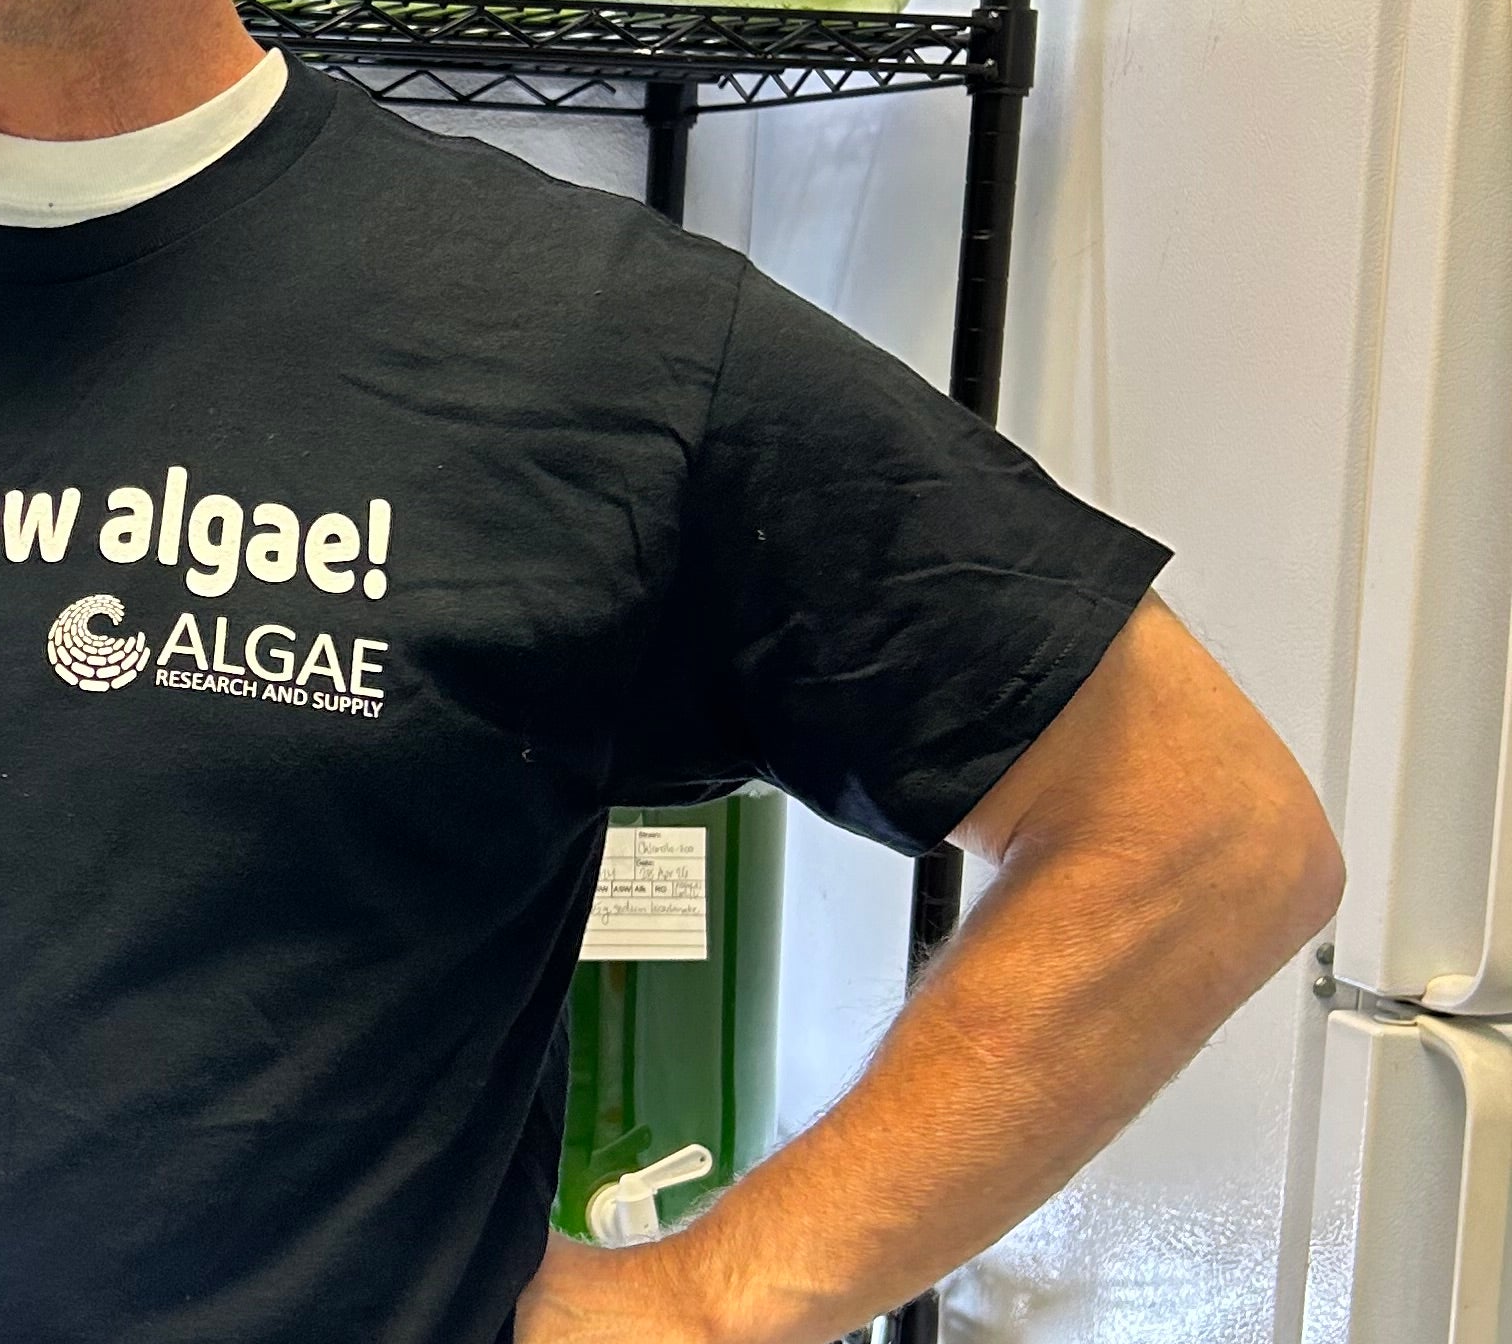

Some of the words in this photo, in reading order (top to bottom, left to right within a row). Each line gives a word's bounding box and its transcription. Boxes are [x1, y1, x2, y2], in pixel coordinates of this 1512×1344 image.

[98, 466, 393, 600] algae!
[155, 668, 258, 699] RESEARCH
[262, 682, 309, 706] AND
[313, 688, 384, 719] SUPPLY
[156, 612, 390, 699] ALGAE
